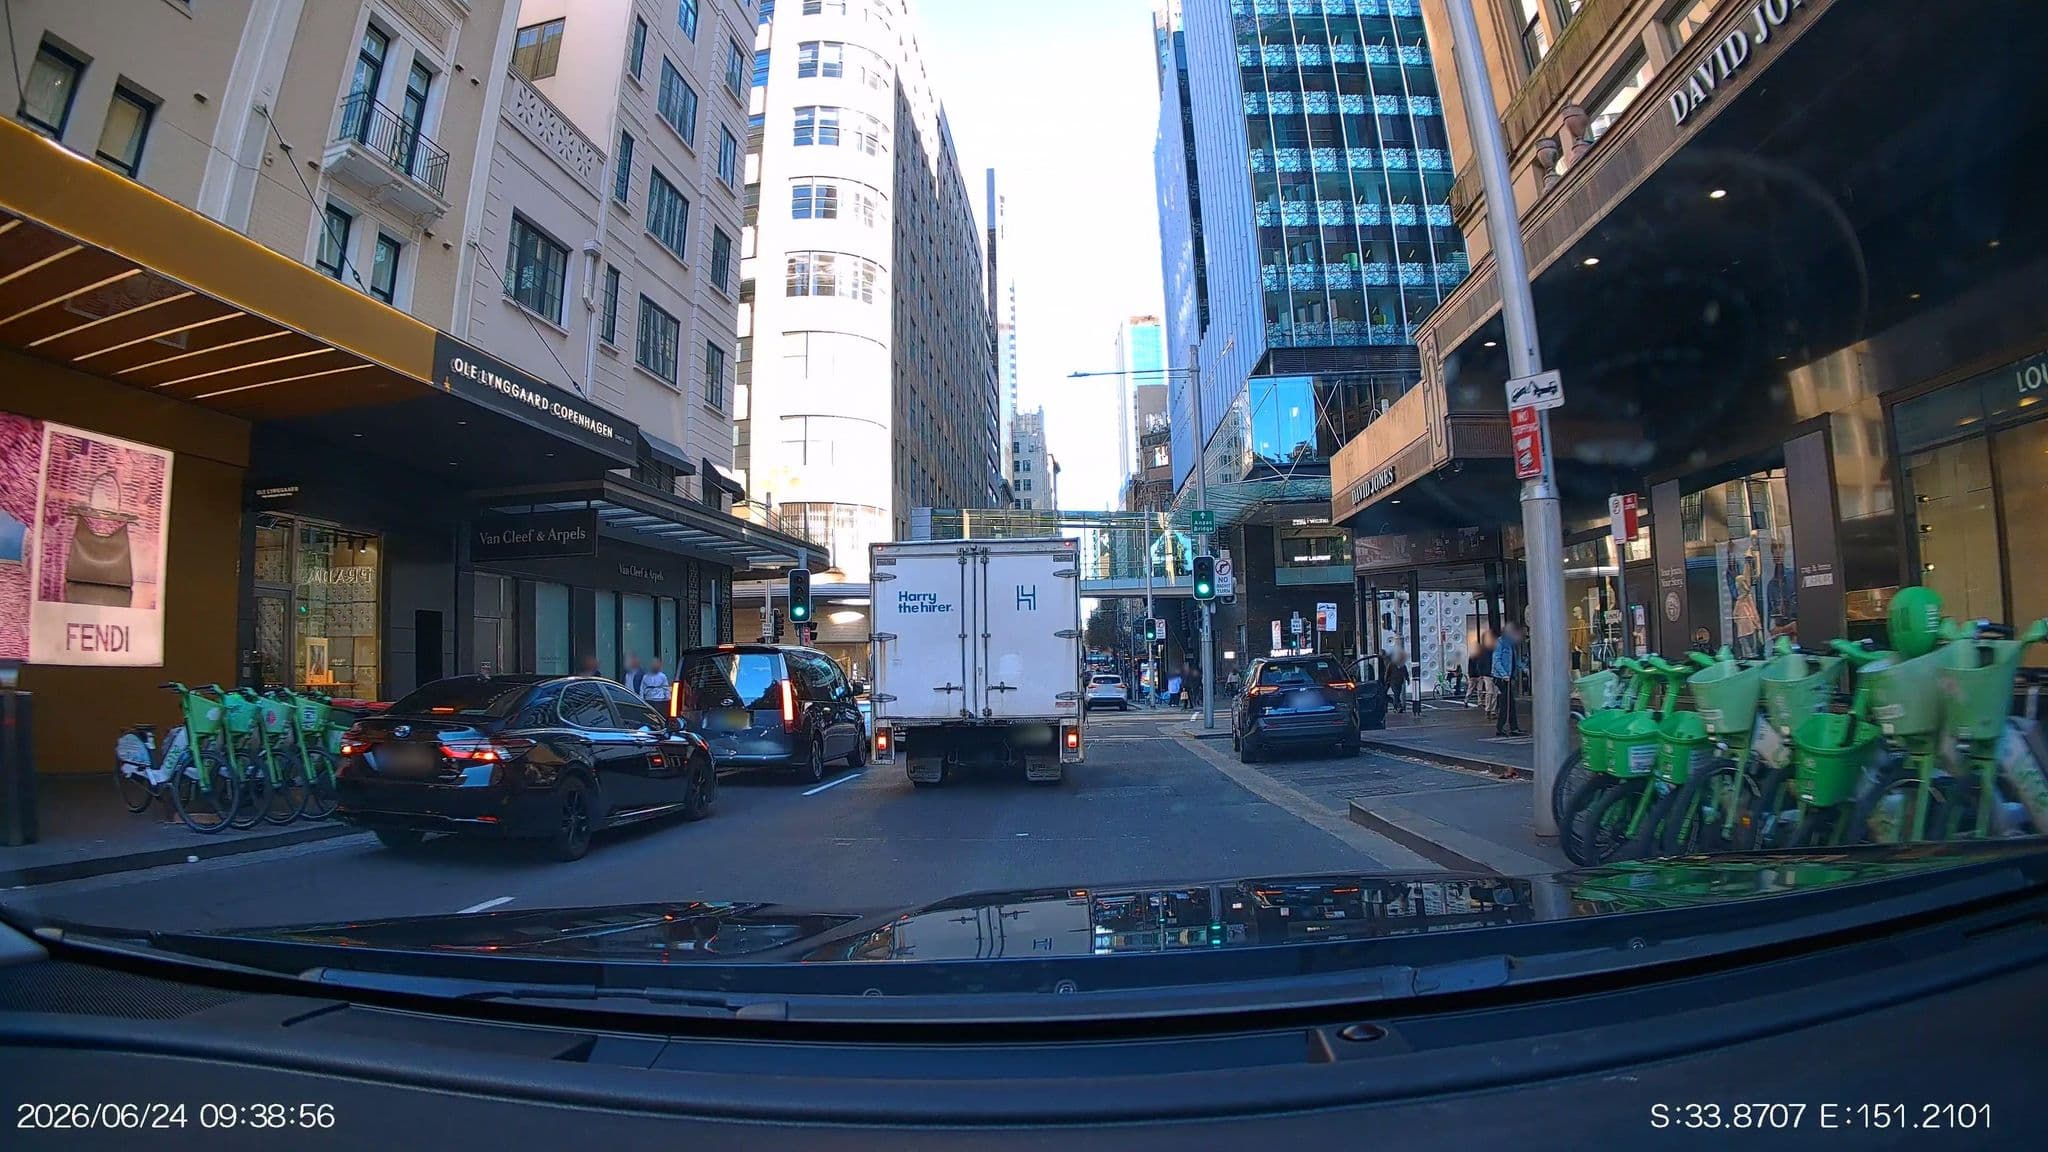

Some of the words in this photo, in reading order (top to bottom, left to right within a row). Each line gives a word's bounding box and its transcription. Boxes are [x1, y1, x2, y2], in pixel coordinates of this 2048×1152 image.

[1669, 30, 1749, 126] DAVID
[453, 358, 477, 380] OLE
[480, 369, 550, 411] LYNGGAARD
[553, 402, 614, 439] COPENHAGEN
[1351, 481, 1370, 505] DAVID
[1371, 466, 1394, 494] JONES
[480, 532, 500, 545] Van
[502, 528, 534, 544] Cleef
[536, 531, 545, 542] &
[547, 526, 586, 545] Arpels
[899, 591, 937, 604] Harry
[66, 623, 130, 653] FENDI
